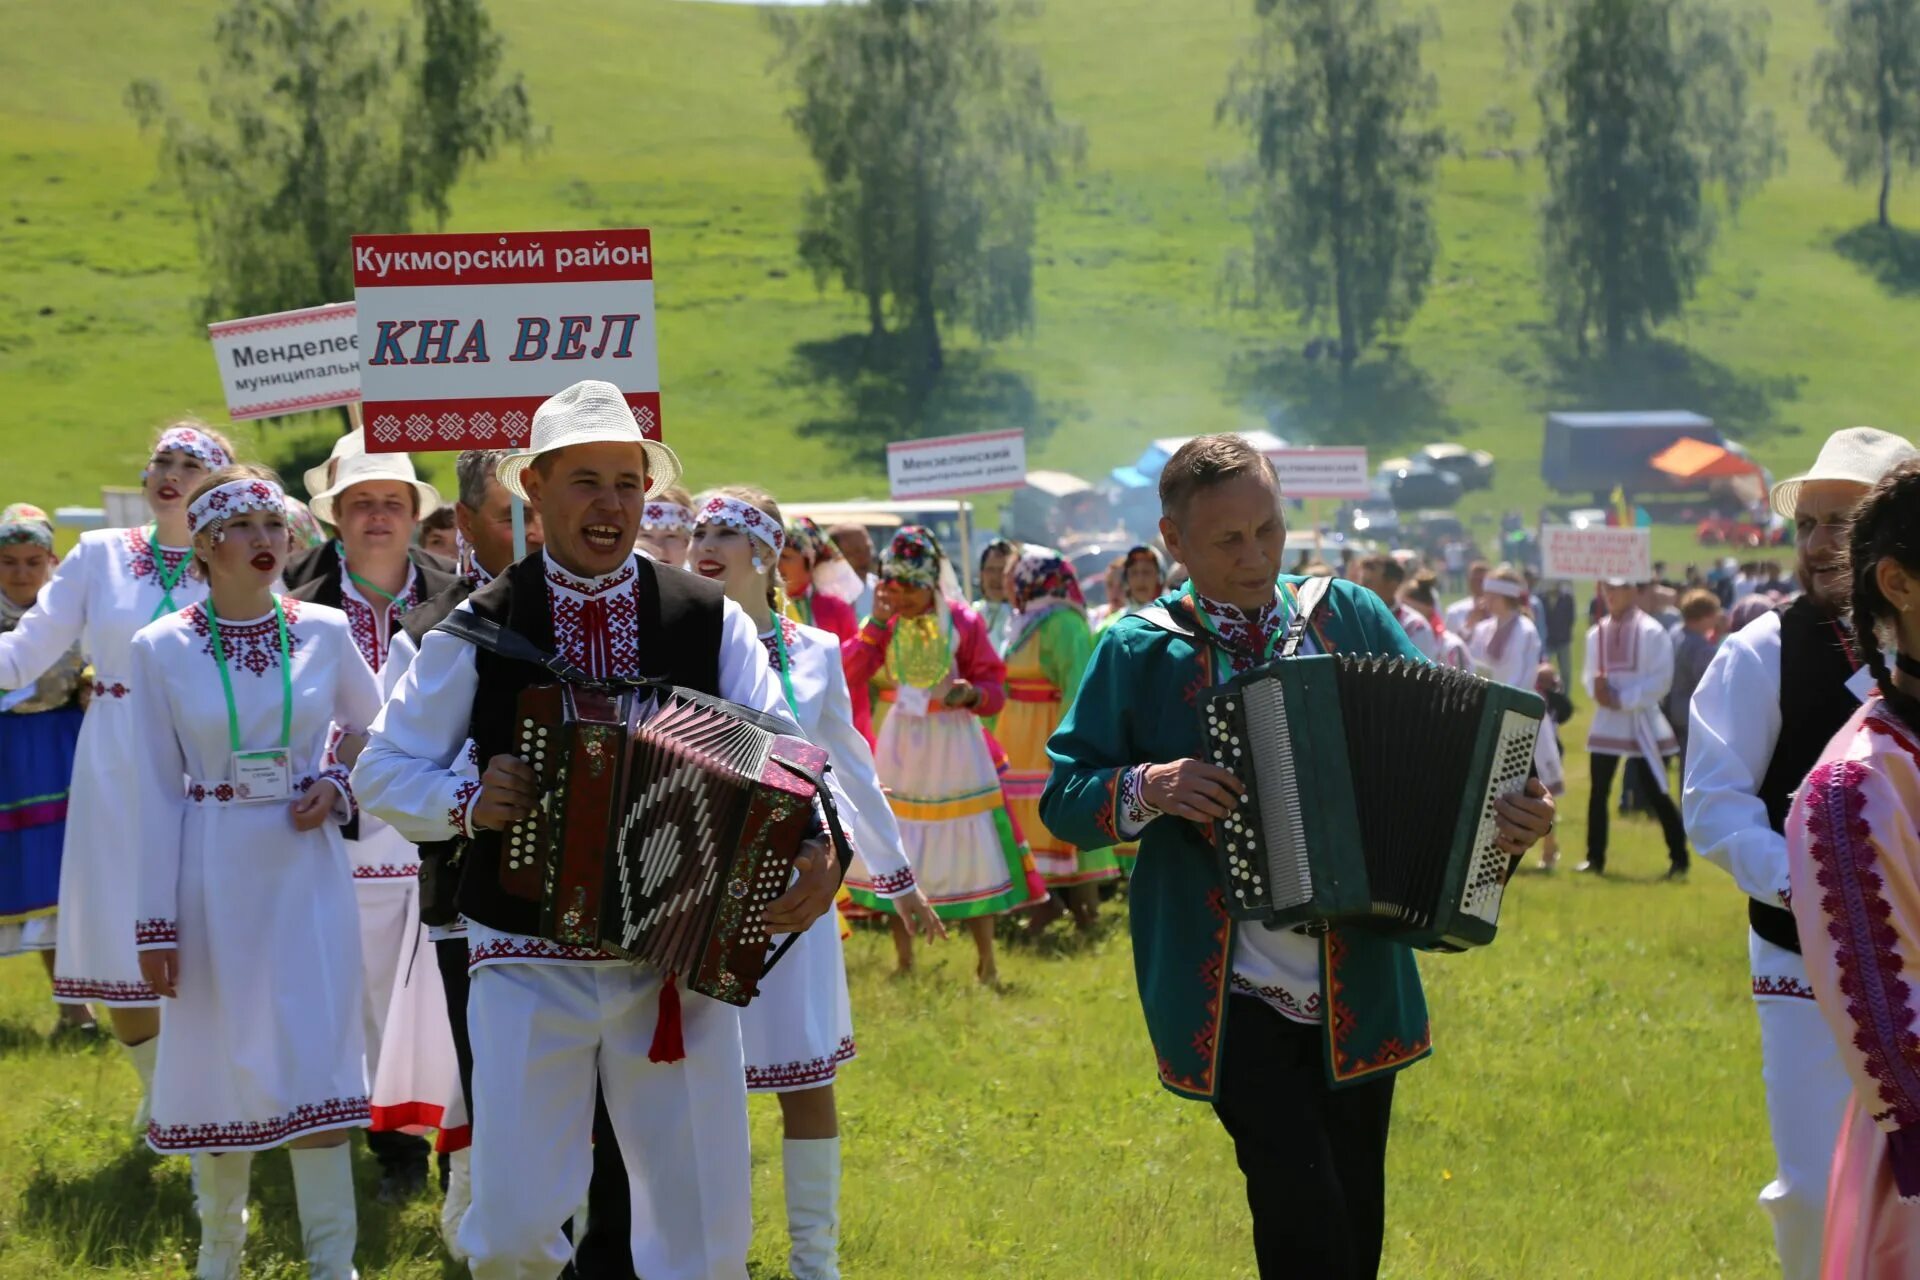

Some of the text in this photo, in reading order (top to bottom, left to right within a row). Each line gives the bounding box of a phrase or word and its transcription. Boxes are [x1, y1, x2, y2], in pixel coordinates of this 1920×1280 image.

[356, 240, 649, 277] Кукморский район
[368, 314, 641, 365] КНА ВЕЛ
